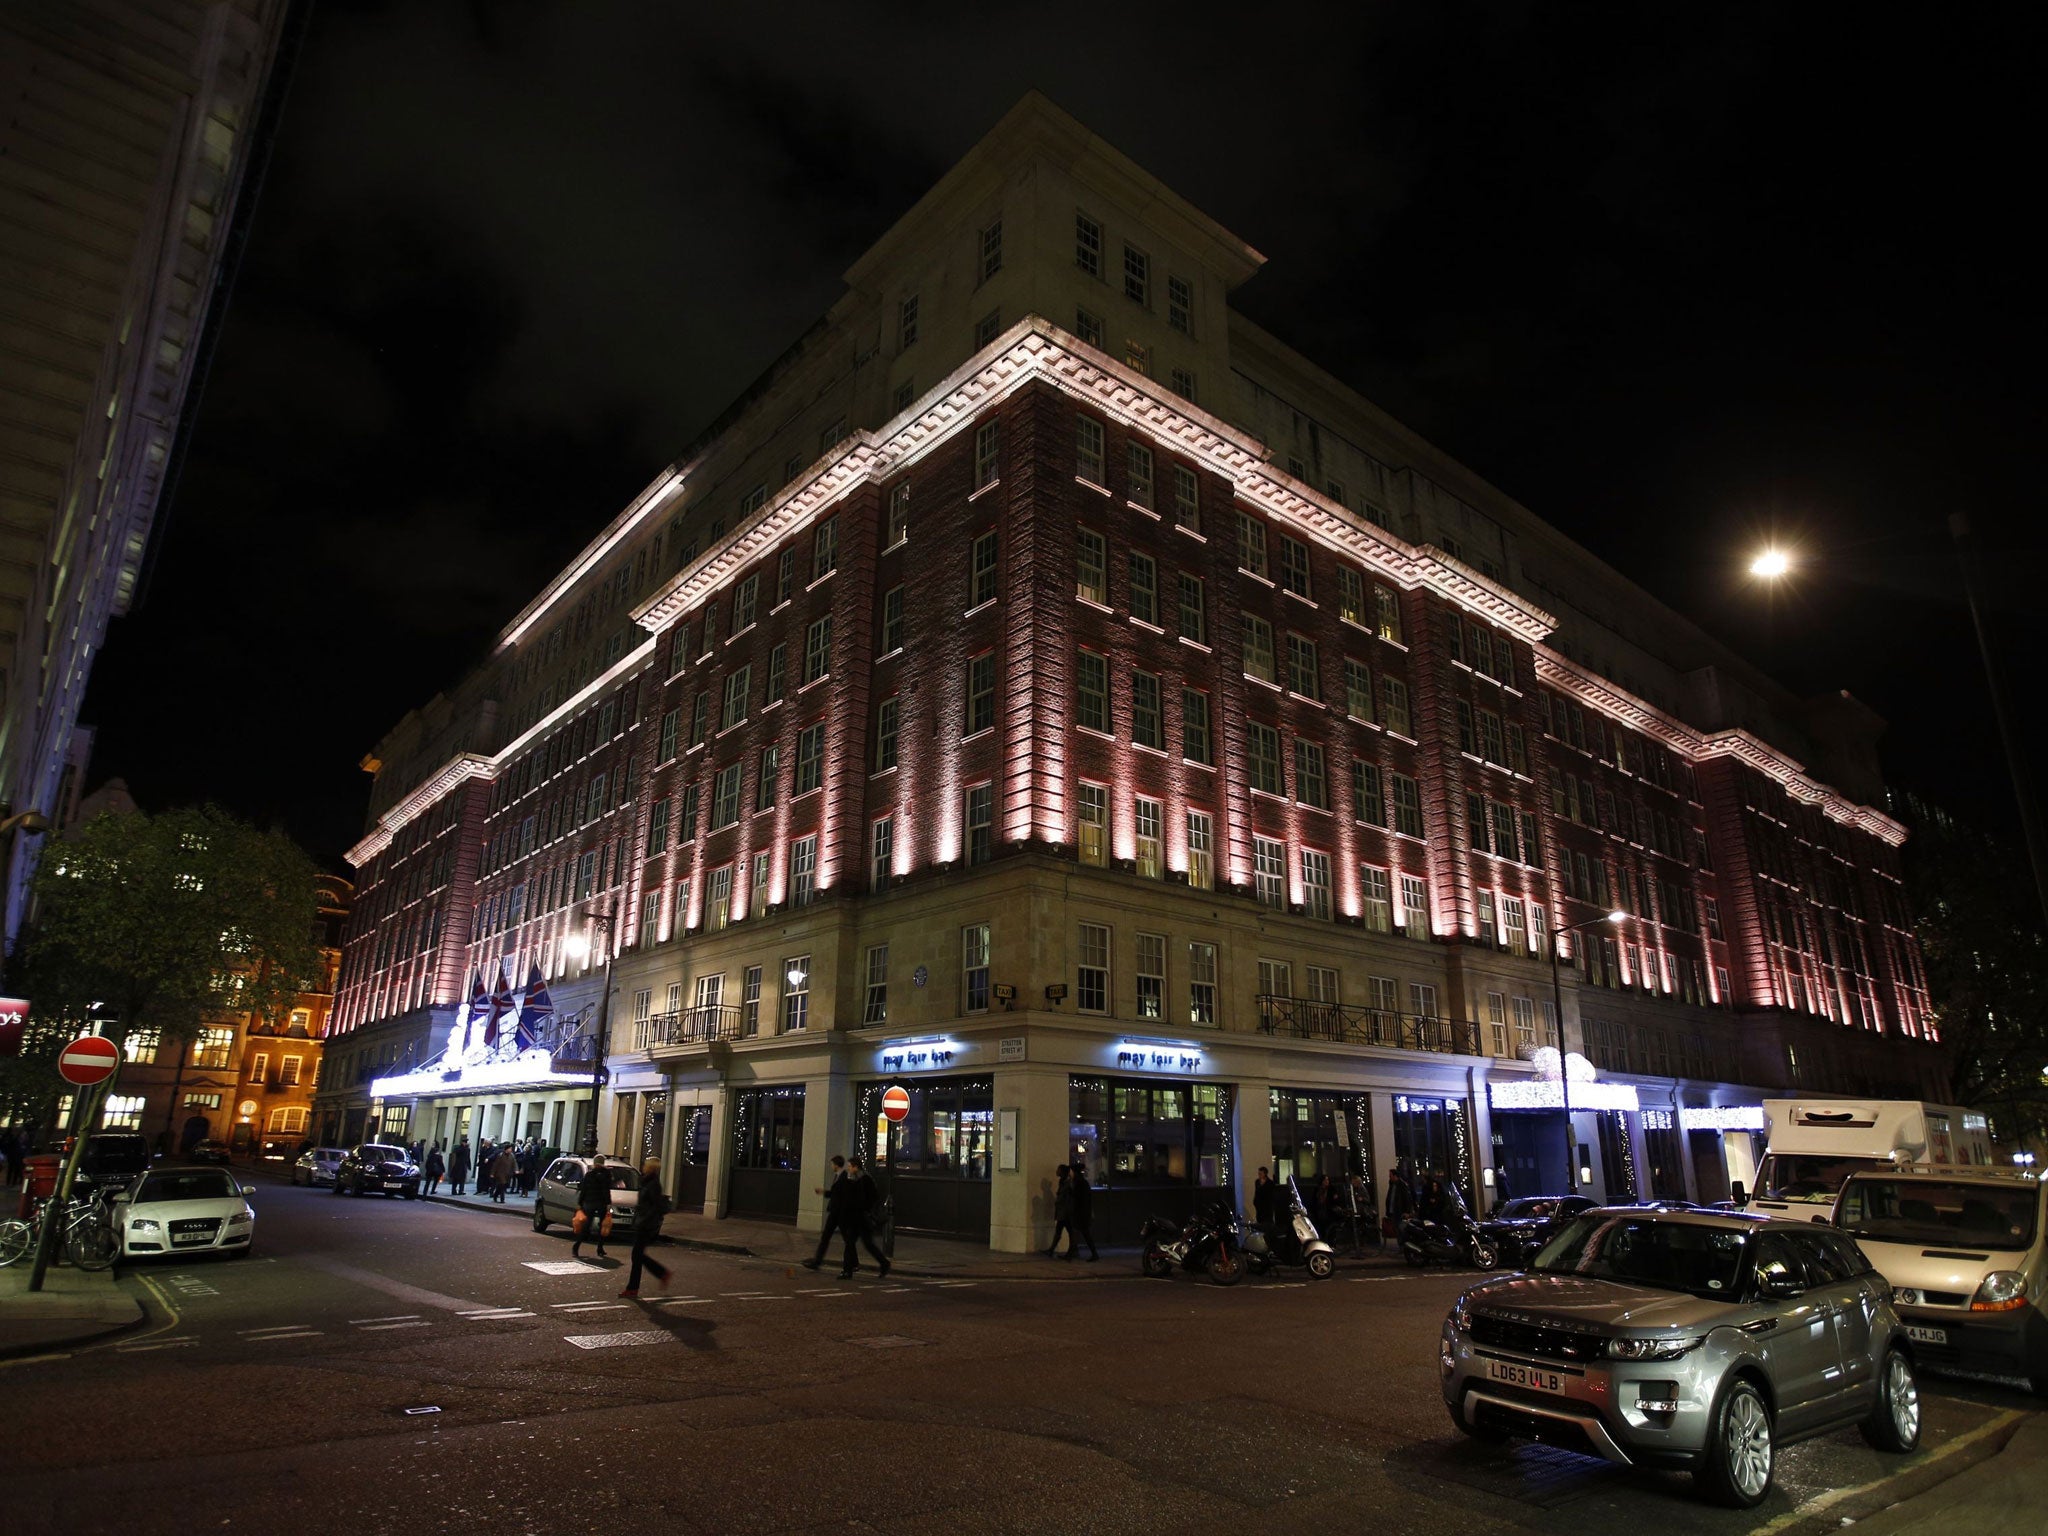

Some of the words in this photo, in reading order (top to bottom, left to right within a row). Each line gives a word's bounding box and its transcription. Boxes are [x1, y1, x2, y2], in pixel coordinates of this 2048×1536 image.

[883, 1054, 904, 1069] may
[907, 1050, 927, 1065] fair
[931, 1049, 953, 1063] bar
[1118, 1051, 1146, 1067] may
[1151, 1051, 1174, 1066] fair
[1179, 1052, 1201, 1068] bar
[1479, 1307, 1530, 1322] RANGE
[1539, 1318, 1600, 1333] ROVER
[1919, 1328, 1944, 1342] HJG
[1491, 1362, 1526, 1384] LD63
[1529, 1370, 1559, 1391] ULB
